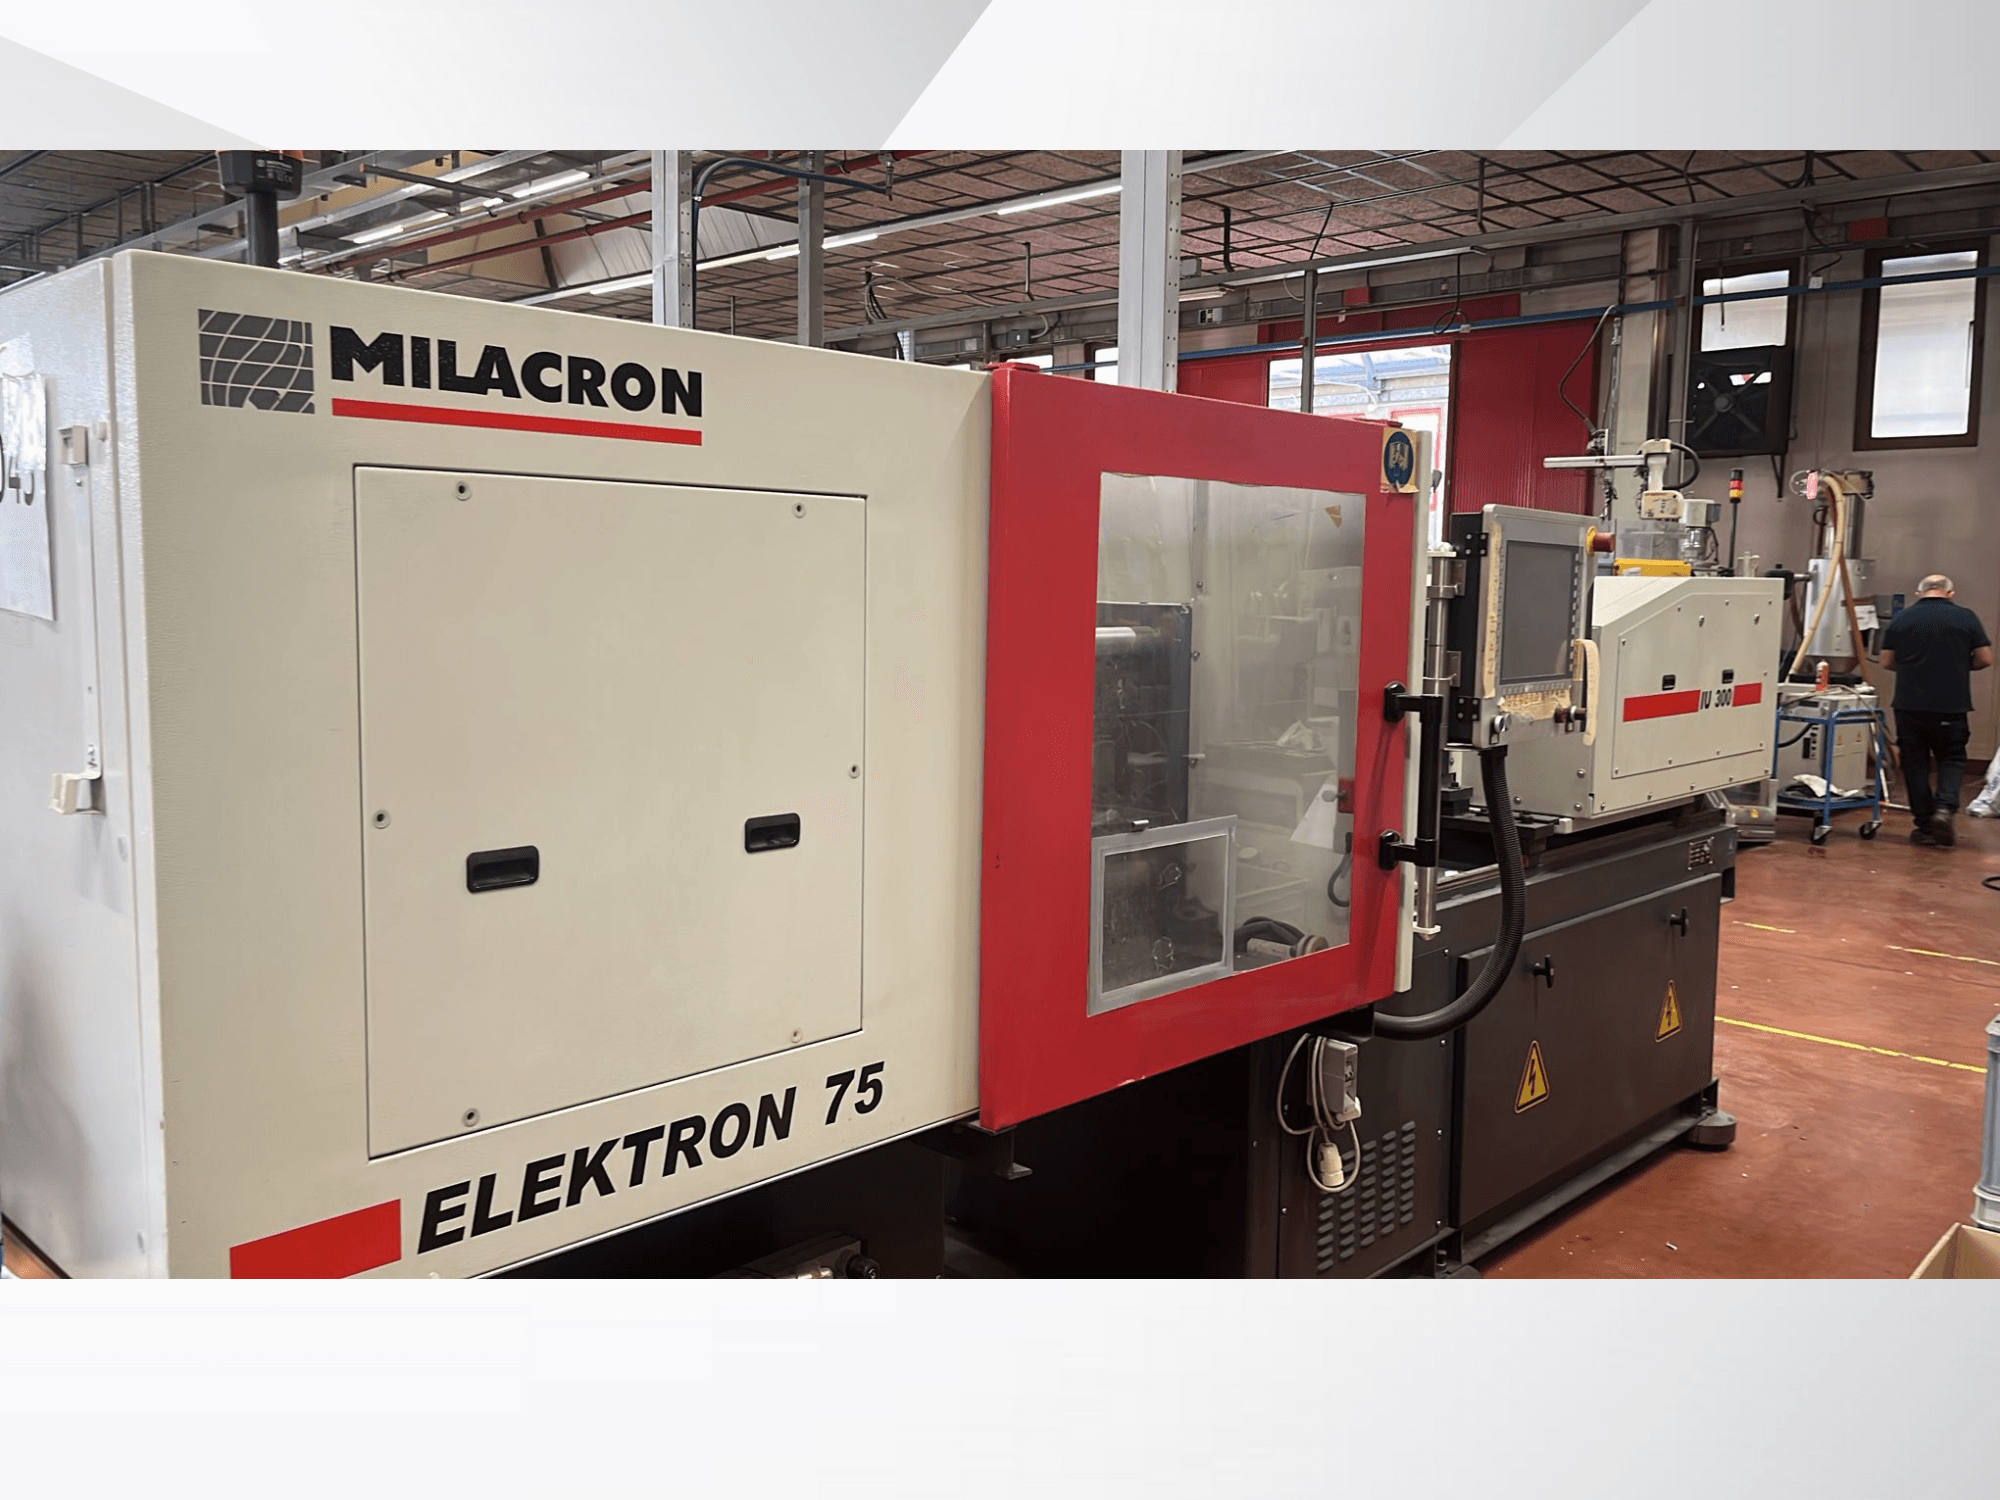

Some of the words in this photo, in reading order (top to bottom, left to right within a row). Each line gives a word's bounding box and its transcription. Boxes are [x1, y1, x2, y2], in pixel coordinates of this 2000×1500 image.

[330, 325, 702, 418] MILACRON
[1700, 690, 1712, 710] IU
[1715, 688, 1732, 708] 300
[417, 1086, 797, 1255] ELEKTRON
[825, 1061, 885, 1125] 75
